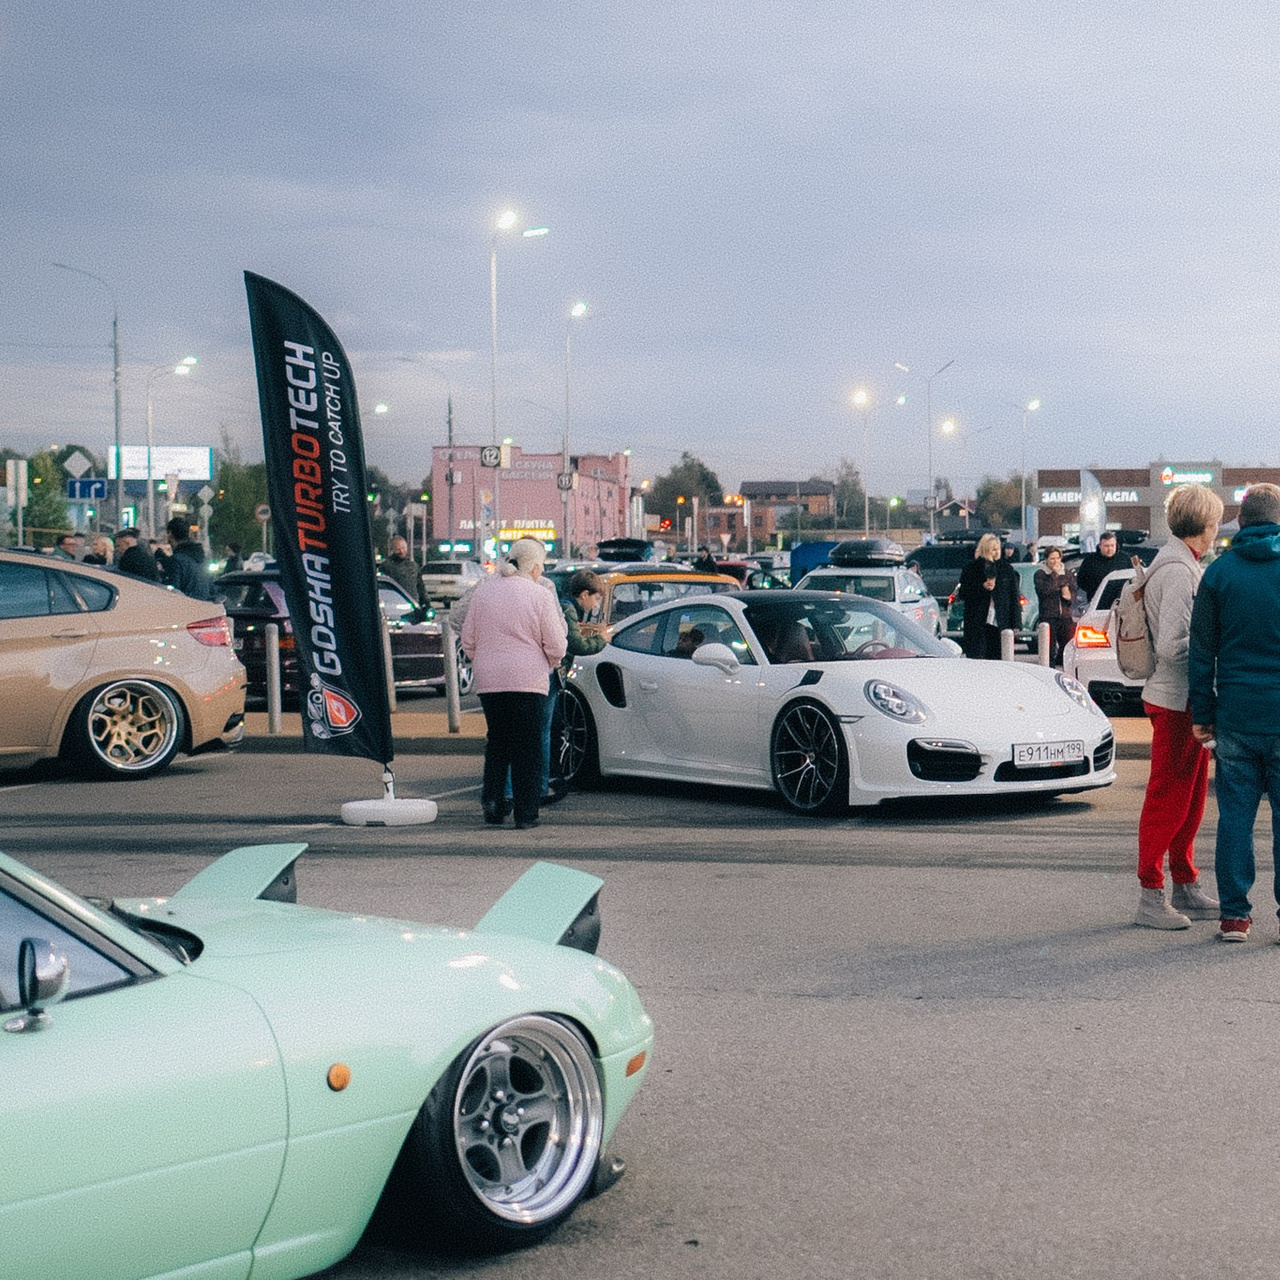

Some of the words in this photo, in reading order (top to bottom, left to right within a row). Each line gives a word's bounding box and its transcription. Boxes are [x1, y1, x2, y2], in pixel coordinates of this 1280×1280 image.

[322, 351, 341, 380] UP
[324, 382, 345, 446] CATCH
[330, 449, 348, 472] TO
[484, 449, 498, 462] 12
[331, 477, 351, 513] TRY
[1042, 491, 1081, 503] ЗАМЕН
[1066, 742, 1081, 754] 199
